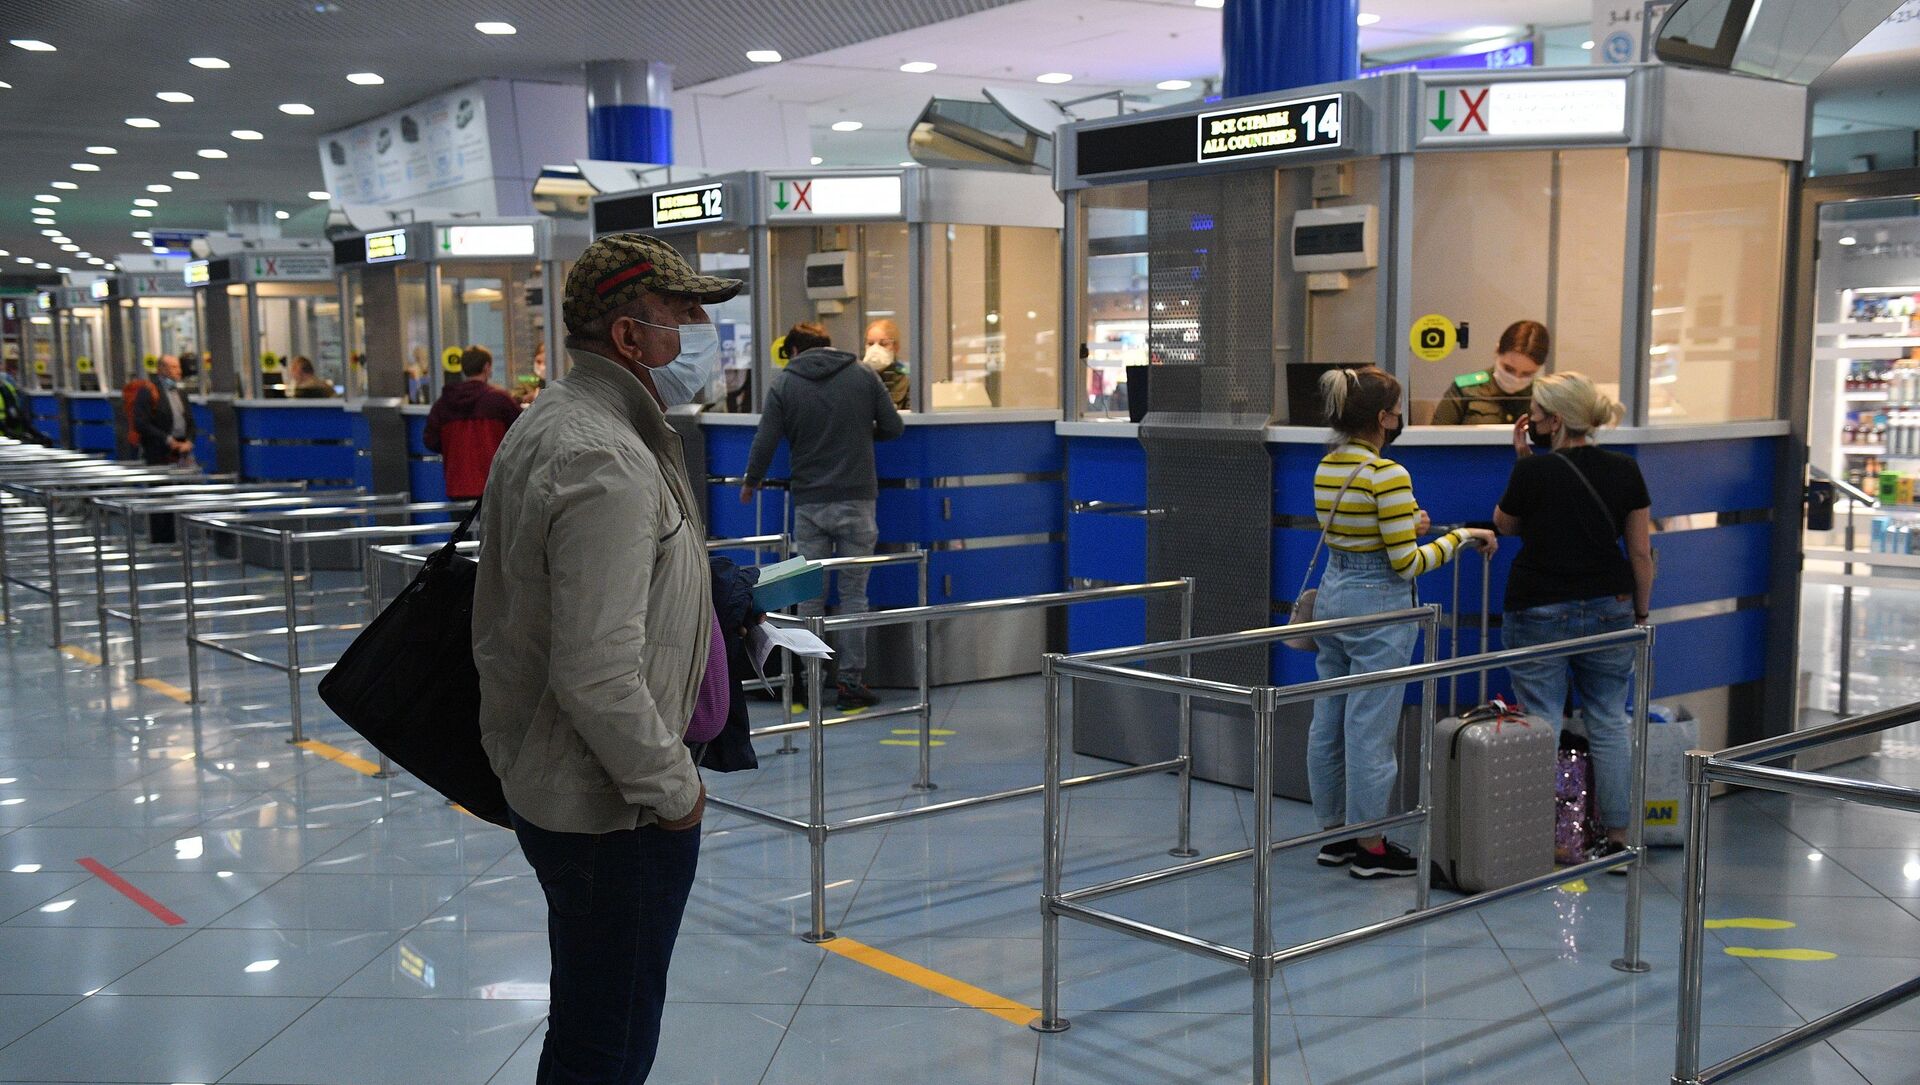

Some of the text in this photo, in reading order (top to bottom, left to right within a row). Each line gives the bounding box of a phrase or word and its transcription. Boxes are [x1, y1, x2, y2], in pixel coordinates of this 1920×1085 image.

[1301, 102, 1340, 142] 14
[1203, 129, 1297, 154] ALL COUNTRIES
[702, 188, 723, 217] 12
